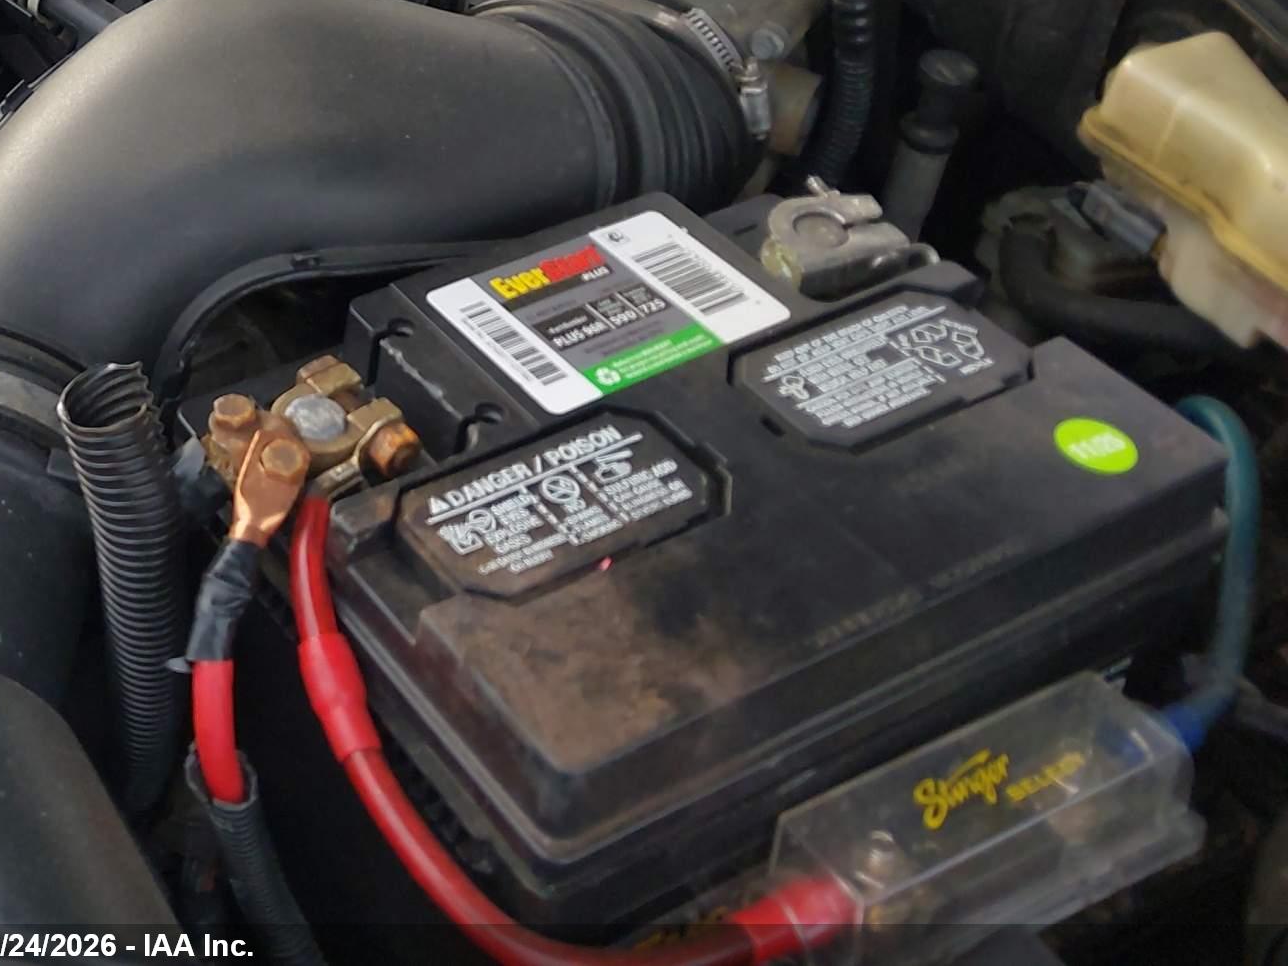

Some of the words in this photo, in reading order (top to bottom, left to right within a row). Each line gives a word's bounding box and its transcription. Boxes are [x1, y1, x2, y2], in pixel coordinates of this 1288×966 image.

[581, 265, 610, 282] PLUS
[444, 462, 534, 508] DANGER
[543, 424, 624, 467] POISON
[913, 748, 1009, 829] Stinger
